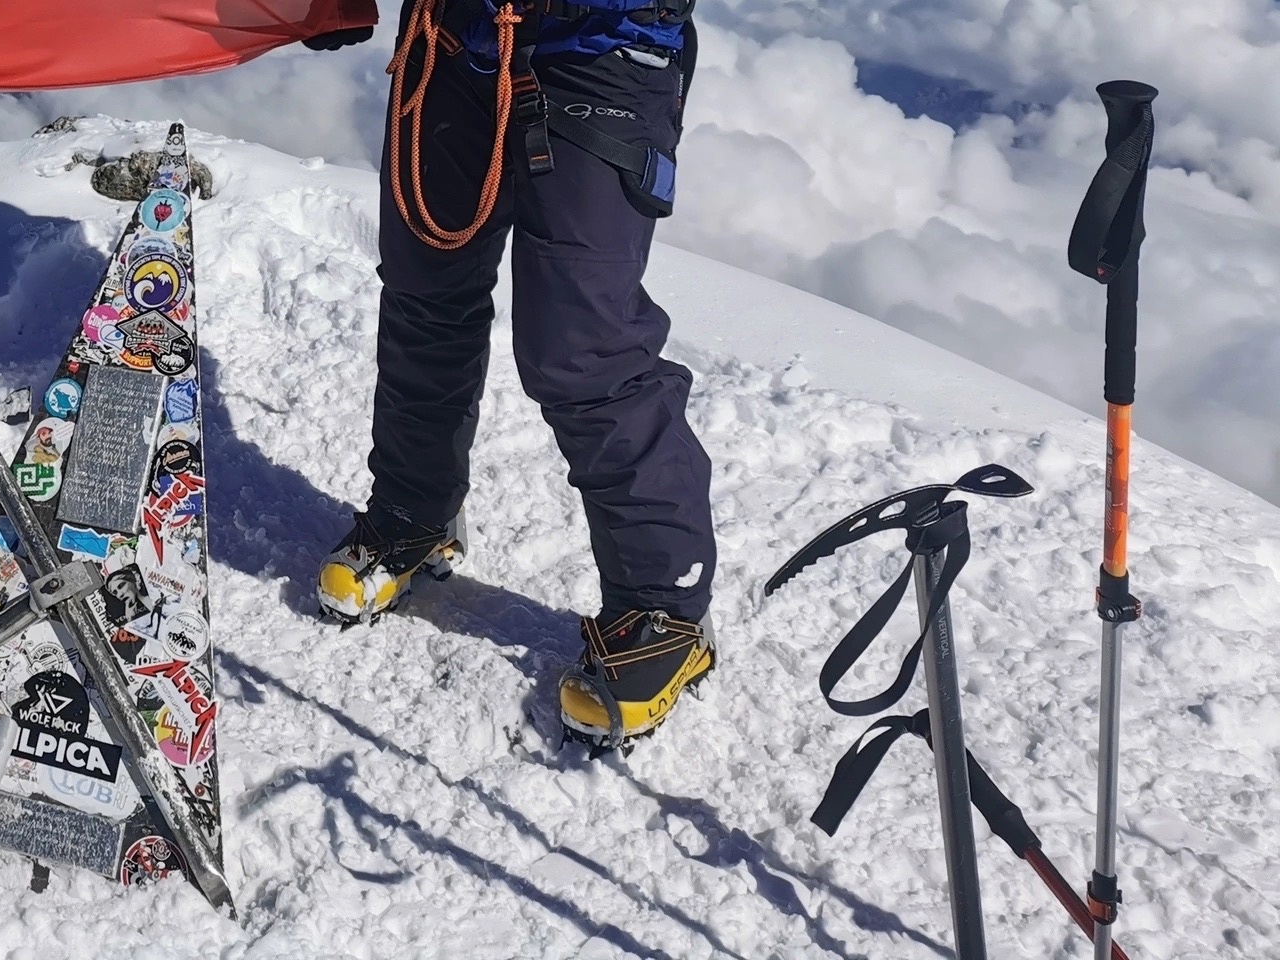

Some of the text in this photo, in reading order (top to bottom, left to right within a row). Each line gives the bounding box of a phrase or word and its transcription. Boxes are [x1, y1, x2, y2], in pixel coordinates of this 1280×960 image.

[939, 616, 950, 659] VERTICAL
[19, 708, 52, 727] WOLF
[129, 658, 217, 766] ALPICA
[12, 726, 112, 777] LPICA
